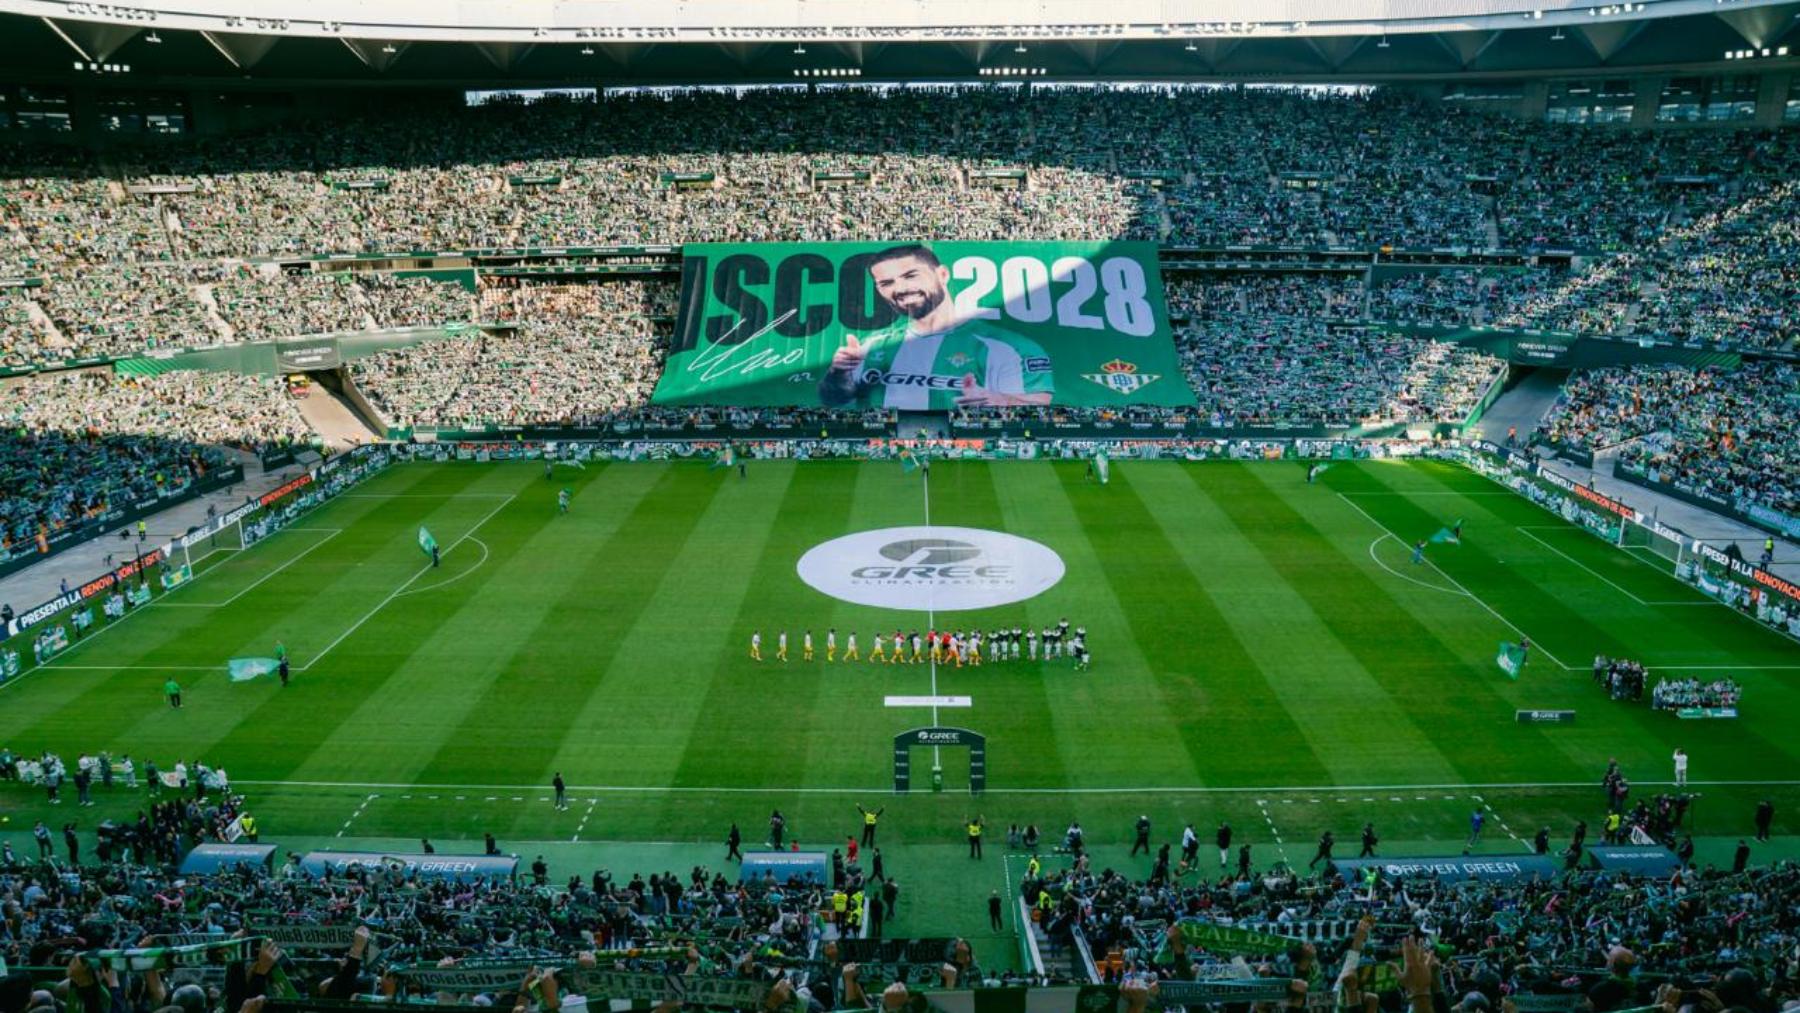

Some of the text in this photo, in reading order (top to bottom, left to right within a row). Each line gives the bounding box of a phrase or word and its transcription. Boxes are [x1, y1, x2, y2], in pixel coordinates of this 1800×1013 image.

[670, 252, 1157, 353] ISCO 2028
[883, 373, 965, 388] GREE
[851, 566, 1012, 579] GREE
[1741, 562, 1754, 578] LA
[21, 597, 69, 629] PRESENTA
[68, 590, 82, 607] LA
[929, 732, 960, 740] GREE
[421, 861, 477, 873] GREEN
[1463, 862, 1521, 874] GREEN
